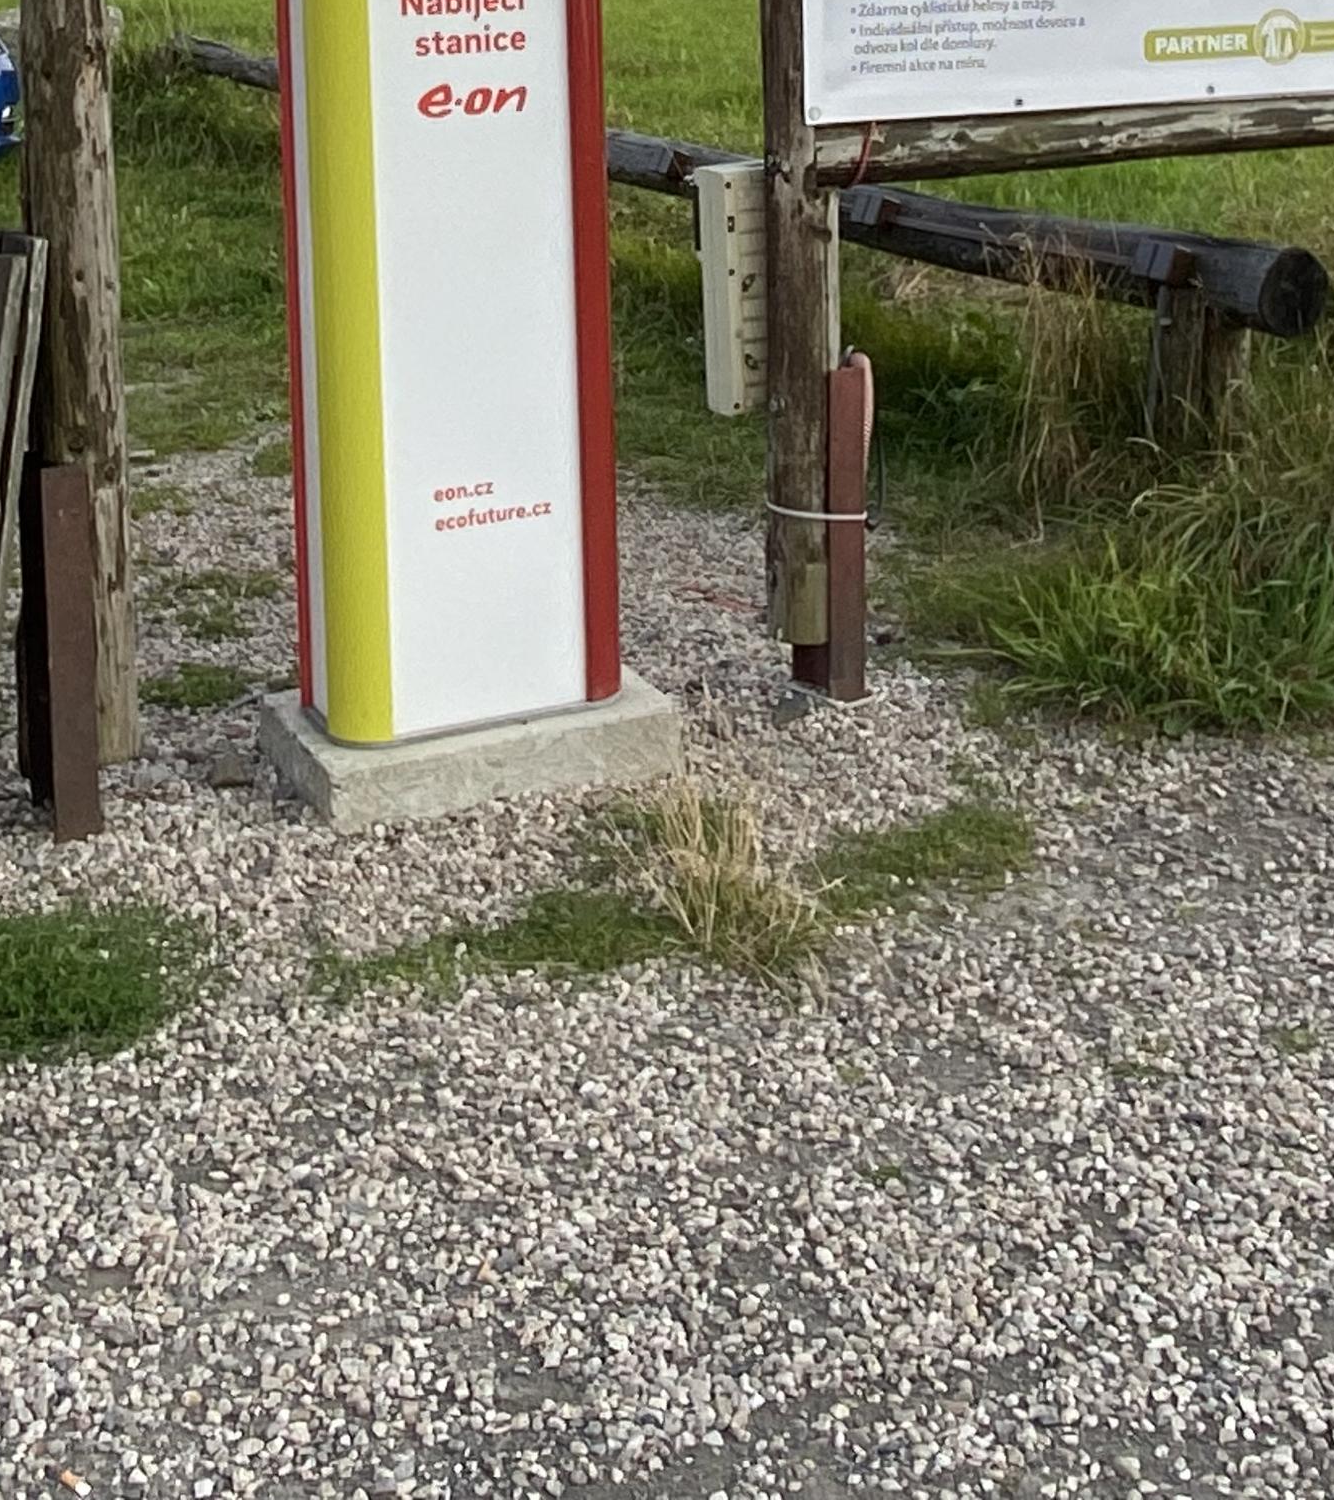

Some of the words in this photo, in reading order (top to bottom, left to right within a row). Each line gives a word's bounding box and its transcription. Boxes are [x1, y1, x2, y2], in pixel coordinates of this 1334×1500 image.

[858, 2, 908, 17] Zdarma
[909, 0, 968, 18] cyklistické
[1011, 1, 1019, 11] a
[982, 17, 1034, 32] možnost
[1077, 18, 1085, 28] a
[415, 24, 527, 58] stanice
[853, 41, 899, 55] odvozu
[900, 38, 919, 52] kol
[920, 37, 941, 52] dle
[1154, 33, 1249, 55] PARTNER
[858, 60, 908, 75] Firemní
[908, 57, 937, 73] akce
[937, 58, 954, 71] na
[433, 481, 494, 502] eon.cz
[434, 501, 552, 532] ecofuture.cz
